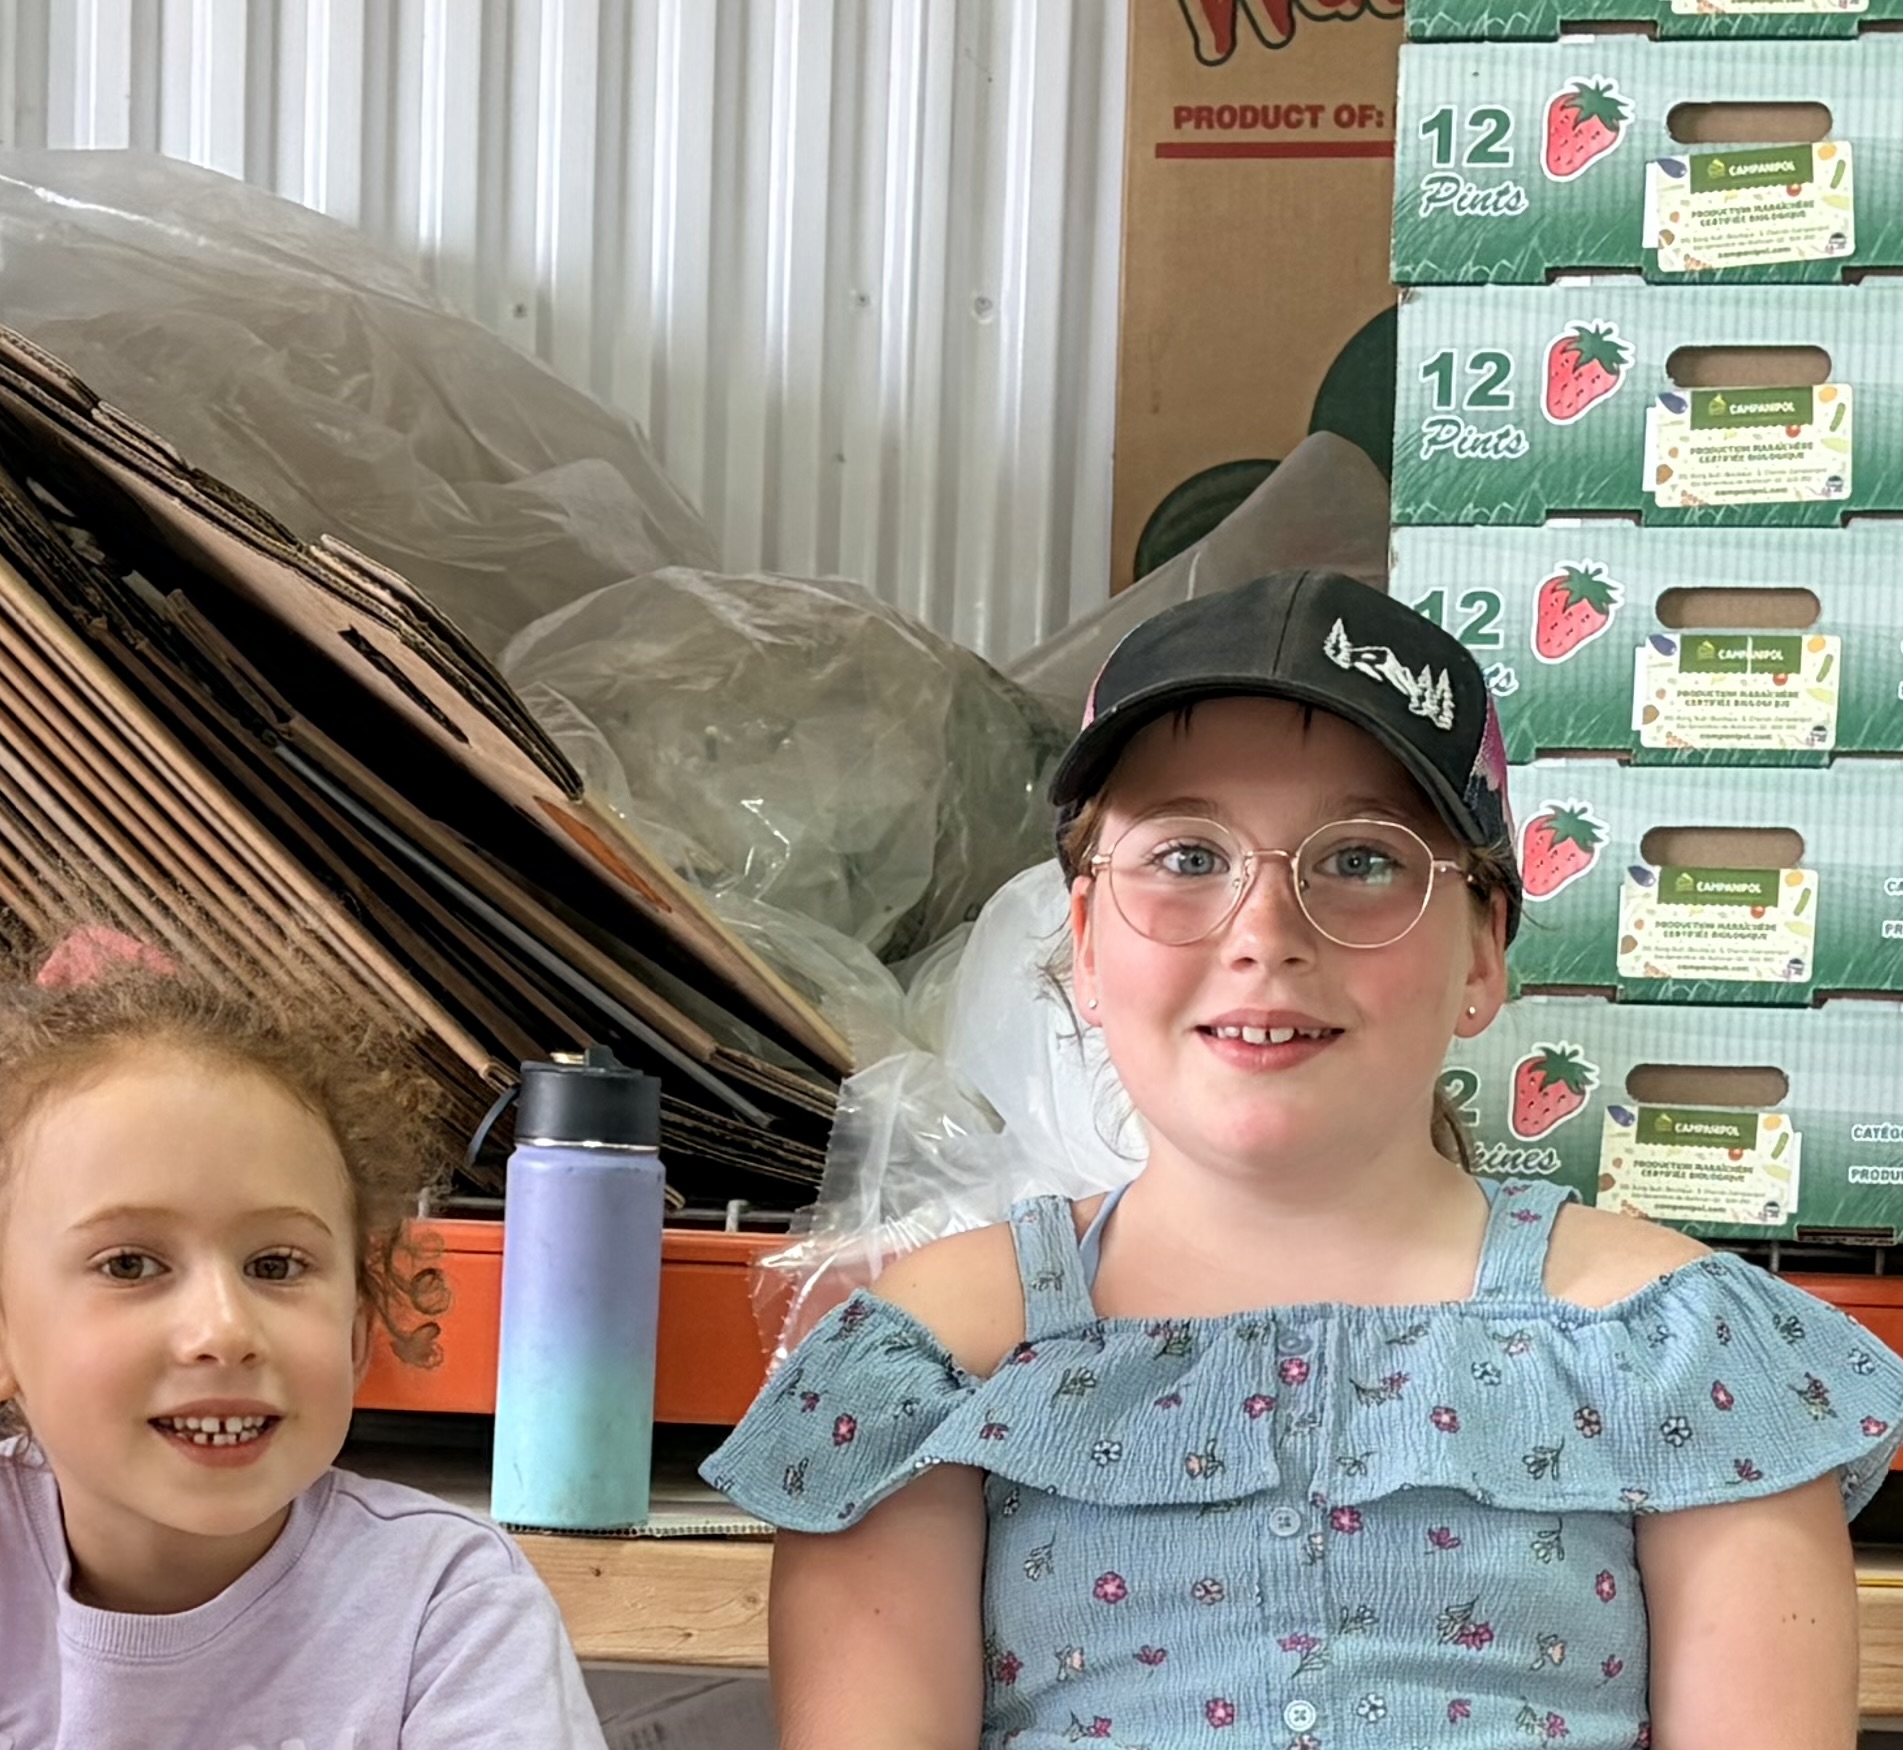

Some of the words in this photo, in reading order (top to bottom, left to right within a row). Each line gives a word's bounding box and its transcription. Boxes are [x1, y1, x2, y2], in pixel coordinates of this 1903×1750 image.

[1173, 104, 1325, 130] PRODUCT
[1333, 103, 1384, 129] OF:
[1420, 106, 1513, 167] 12
[1728, 160, 1795, 177] CAMPANIPOL
[1421, 173, 1528, 216] Pints
[1420, 350, 1513, 408] 12
[1729, 401, 1796, 416] CAMPANIPOL
[1421, 417, 1528, 459] Pints
[1696, 881, 1763, 895] CAMPANIPOL
[1674, 1122, 1740, 1137] CAMPANIPOL
